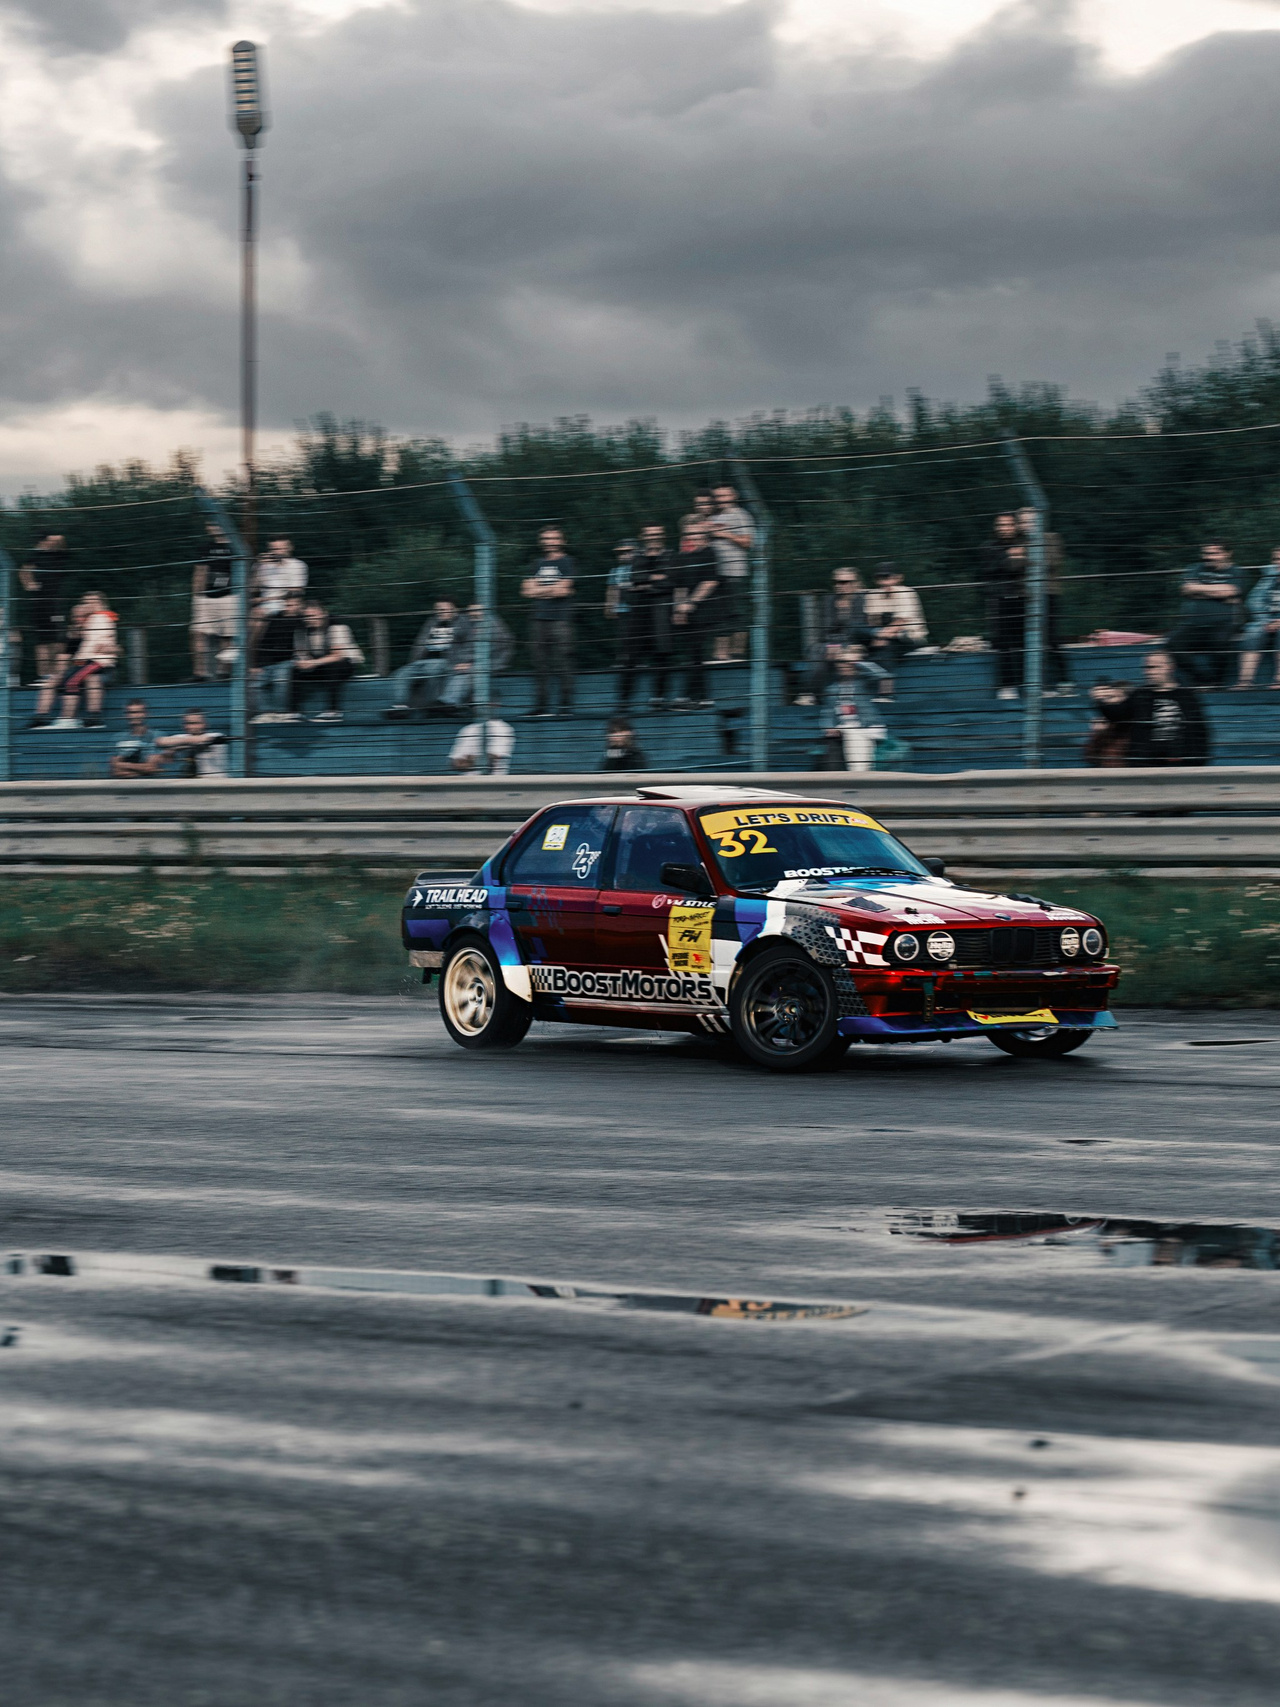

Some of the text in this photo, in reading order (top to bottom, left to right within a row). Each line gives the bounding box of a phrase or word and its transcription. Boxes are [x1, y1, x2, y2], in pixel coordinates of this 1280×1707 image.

[734, 813, 790, 827] LET'S
[709, 829, 779, 858] 32
[425, 888, 488, 904] TRAILHEAD
[683, 900, 717, 908] STYLE
